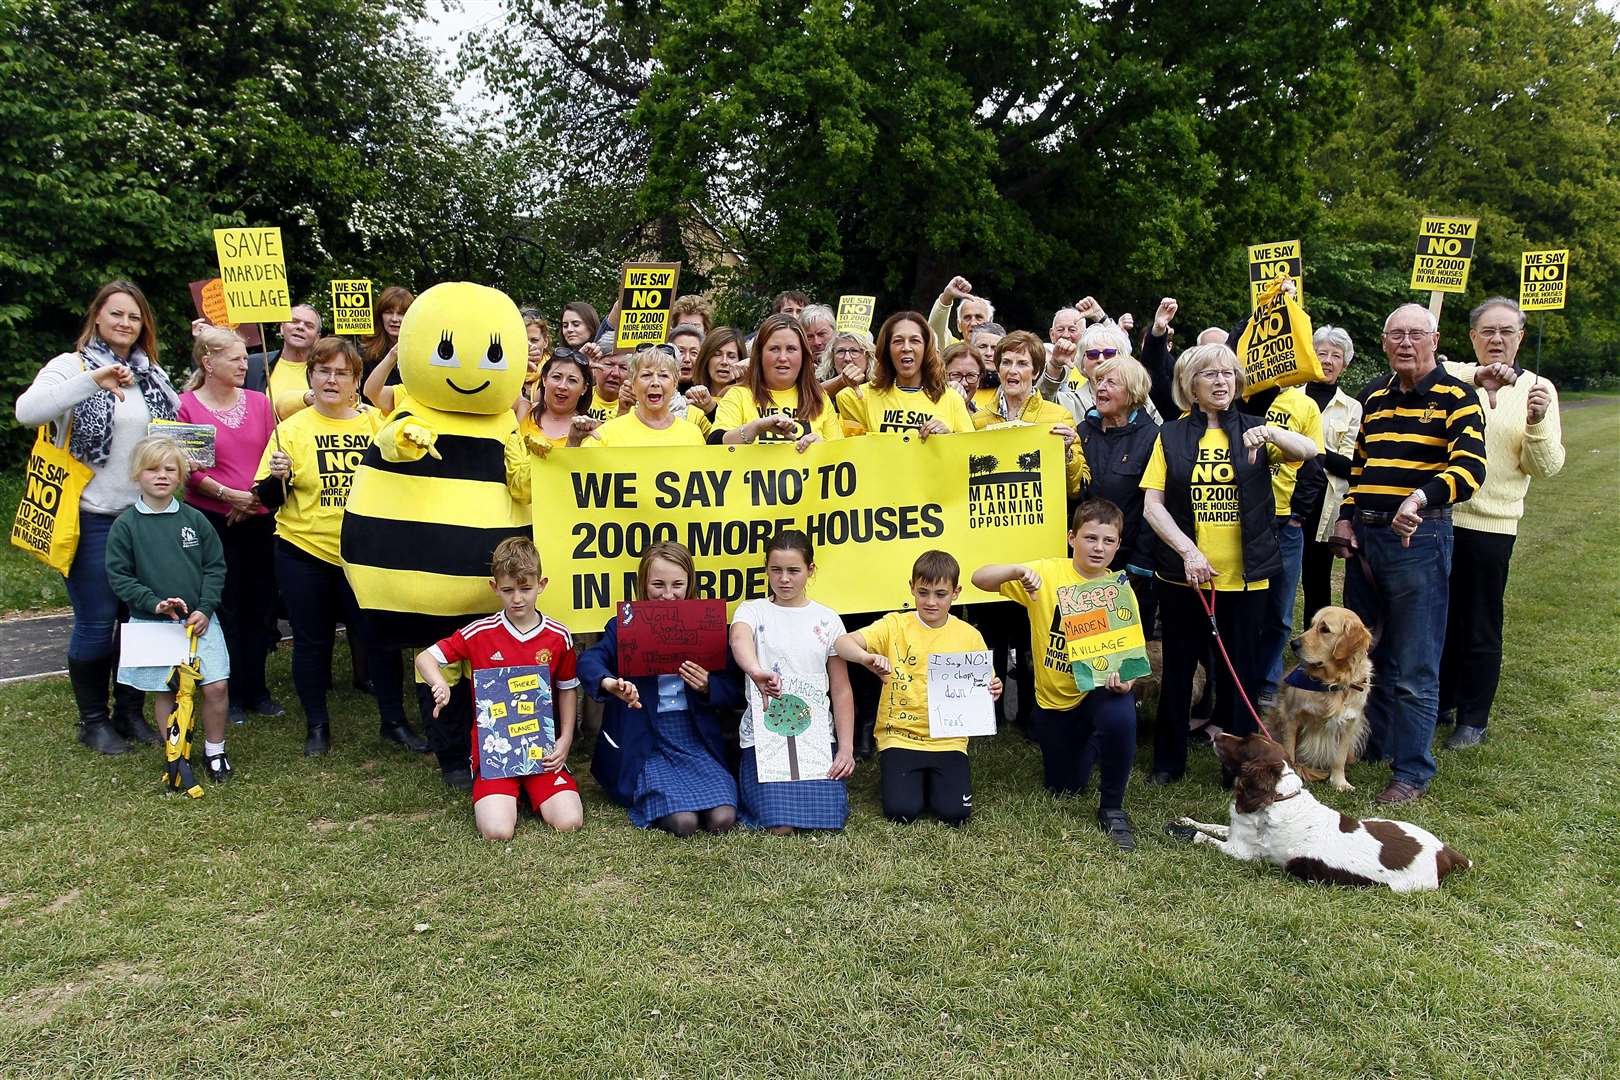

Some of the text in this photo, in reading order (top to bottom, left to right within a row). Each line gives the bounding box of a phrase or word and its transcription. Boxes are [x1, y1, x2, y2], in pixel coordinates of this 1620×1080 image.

[1426, 222, 1472, 236] WE SAY
[224, 232, 278, 258] SAVE
[1254, 245, 1294, 260] WE SAY
[1427, 237, 1462, 256] NO
[1420, 257, 1465, 270] TO 2000
[1525, 252, 1565, 264] WE SAY
[224, 264, 286, 283] MARDEN
[1259, 261, 1290, 279] NO
[1417, 268, 1464, 277] MORE HOUSES
[1530, 265, 1559, 281] NO
[334, 282, 368, 292] WE SAY
[630, 273, 670, 286] WE SAY
[1416, 274, 1463, 285] IN MARDEN
[1524, 282, 1563, 292] TO 2000
[227, 290, 288, 308] VILLAGE
[339, 293, 365, 308] NO
[632, 289, 662, 309] NO
[336, 309, 371, 317] TO 2000
[844, 304, 867, 314] NO
[625, 312, 665, 324] TO 2000
[621, 331, 663, 340] IN MARDEN
[1247, 335, 1294, 366] TO 2000
[1267, 350, 1296, 365] HOUSES
[1257, 359, 1298, 382] MARDEN
[884, 409, 934, 425] WE SAY
[1267, 410, 1291, 425] SAY
[315, 434, 370, 448] WE SAY
[324, 451, 364, 471] NO
[46, 463, 70, 486] SAY
[1191, 463, 1234, 483] NO
[320, 475, 339, 488] TO
[571, 472, 637, 509] WE
[655, 470, 732, 508] SAY
[818, 461, 857, 500] TO
[27, 476, 58, 510] NO
[321, 488, 343, 496] MORE
[969, 482, 1042, 501] MARDEN
[321, 497, 330, 507] IN
[970, 498, 1043, 516] PLANNING
[18, 502, 55, 534] TO 2000
[806, 503, 944, 546] HOUSES
[970, 513, 1044, 529] OPPOSITION
[572, 572, 610, 610] IN
[1057, 584, 1119, 616] Keep
[1065, 618, 1107, 637] MARDEN
[1050, 634, 1066, 651] TO
[1071, 636, 1128, 658] A VILLAGE
[895, 642, 917, 666] We
[930, 652, 988, 668] I Say NO!
[1046, 648, 1069, 661] MORE
[1045, 656, 1053, 669] IN
[891, 666, 913, 682] Say
[928, 669, 974, 681] To chop
[512, 679, 536, 690] THERE
[892, 682, 907, 691] no
[890, 692, 907, 706] to
[494, 707, 504, 717] IS
[511, 723, 536, 734] PLANET
